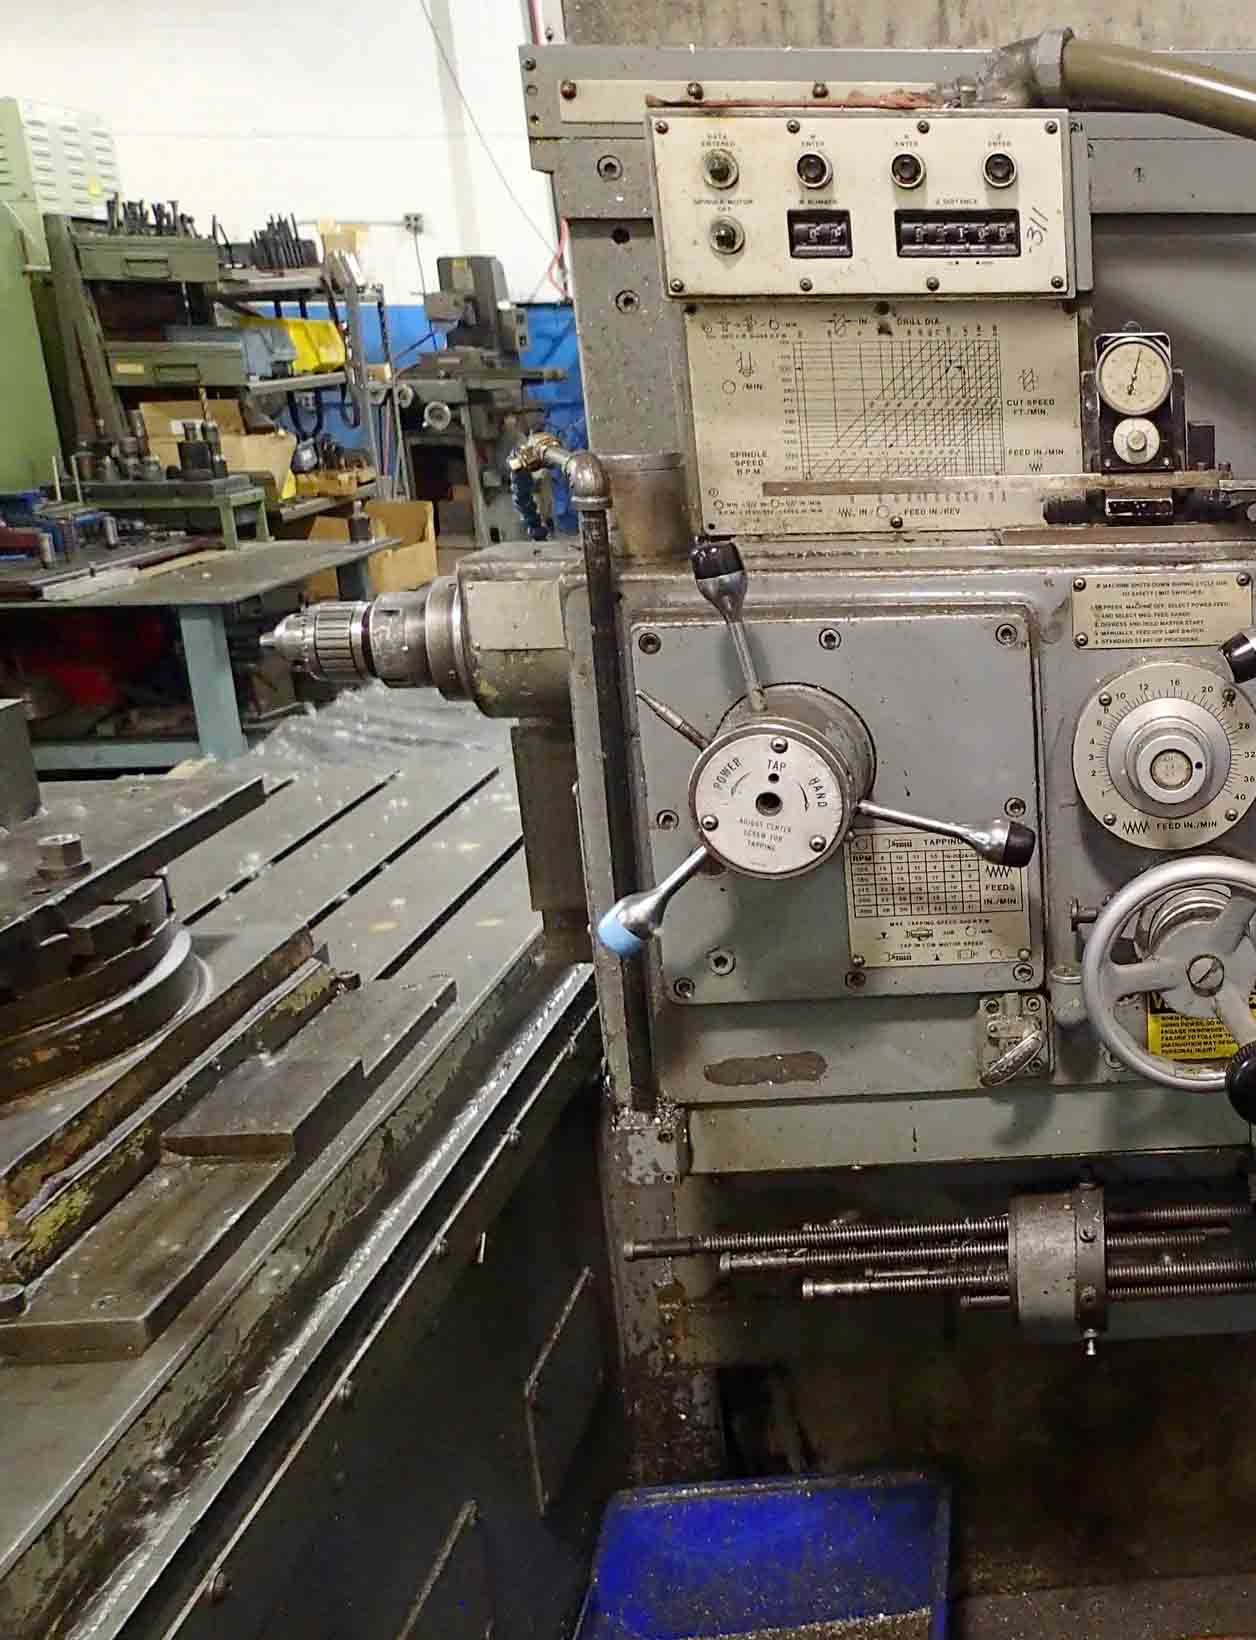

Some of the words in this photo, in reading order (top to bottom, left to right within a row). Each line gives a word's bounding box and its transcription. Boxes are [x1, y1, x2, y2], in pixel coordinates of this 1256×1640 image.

[1006, 399, 1024, 407] CUT
[1027, 398, 1055, 406] SPEED
[1008, 448, 1030, 456] FEED
[734, 459, 764, 467] SPEED
[1139, 683, 1149, 691] 12
[1115, 692, 1126, 700] 10
[1238, 722, 1250, 730] 28
[1089, 737, 1095, 745] 4
[1244, 751, 1256, 759] 32
[768, 759, 787, 772] TAP
[713, 757, 743, 790] POWER
[1090, 769, 1097, 777] 2
[808, 776, 828, 808] HAND
[1234, 793, 1246, 801] 40
[1156, 822, 1181, 830] FEED
[985, 883, 1016, 891] FEEDS
